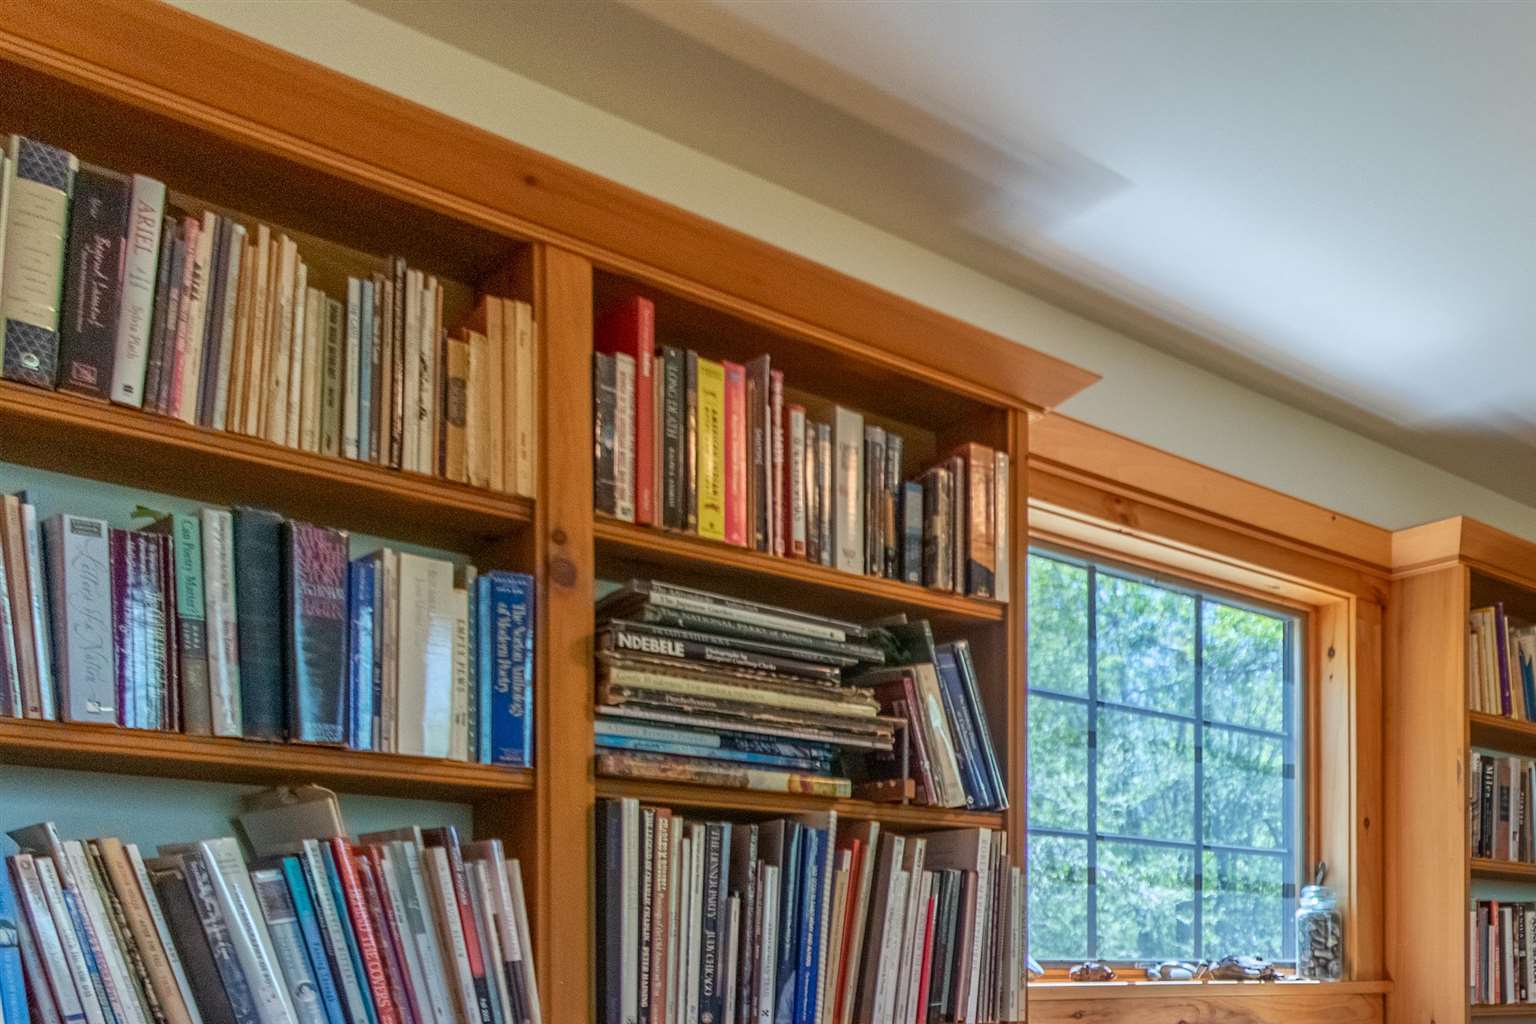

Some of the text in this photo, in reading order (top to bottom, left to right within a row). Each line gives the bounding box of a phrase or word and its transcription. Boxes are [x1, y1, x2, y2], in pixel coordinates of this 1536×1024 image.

[133, 199, 156, 255] ARIEL
[181, 518, 193, 539] Can
[180, 542, 195, 571] Poetry
[494, 602, 509, 693] of Modern Poetry
[508, 602, 524, 717] The Norton Anthology
[616, 633, 686, 658] NDEBELE
[642, 906, 650, 940] CHAPLIN
[703, 830, 719, 996] THE DINNER PARTY JUDY CHICAGO
[360, 933, 379, 961] THE
[368, 959, 391, 1009] COVERS
[640, 974, 649, 1007] HAINING
